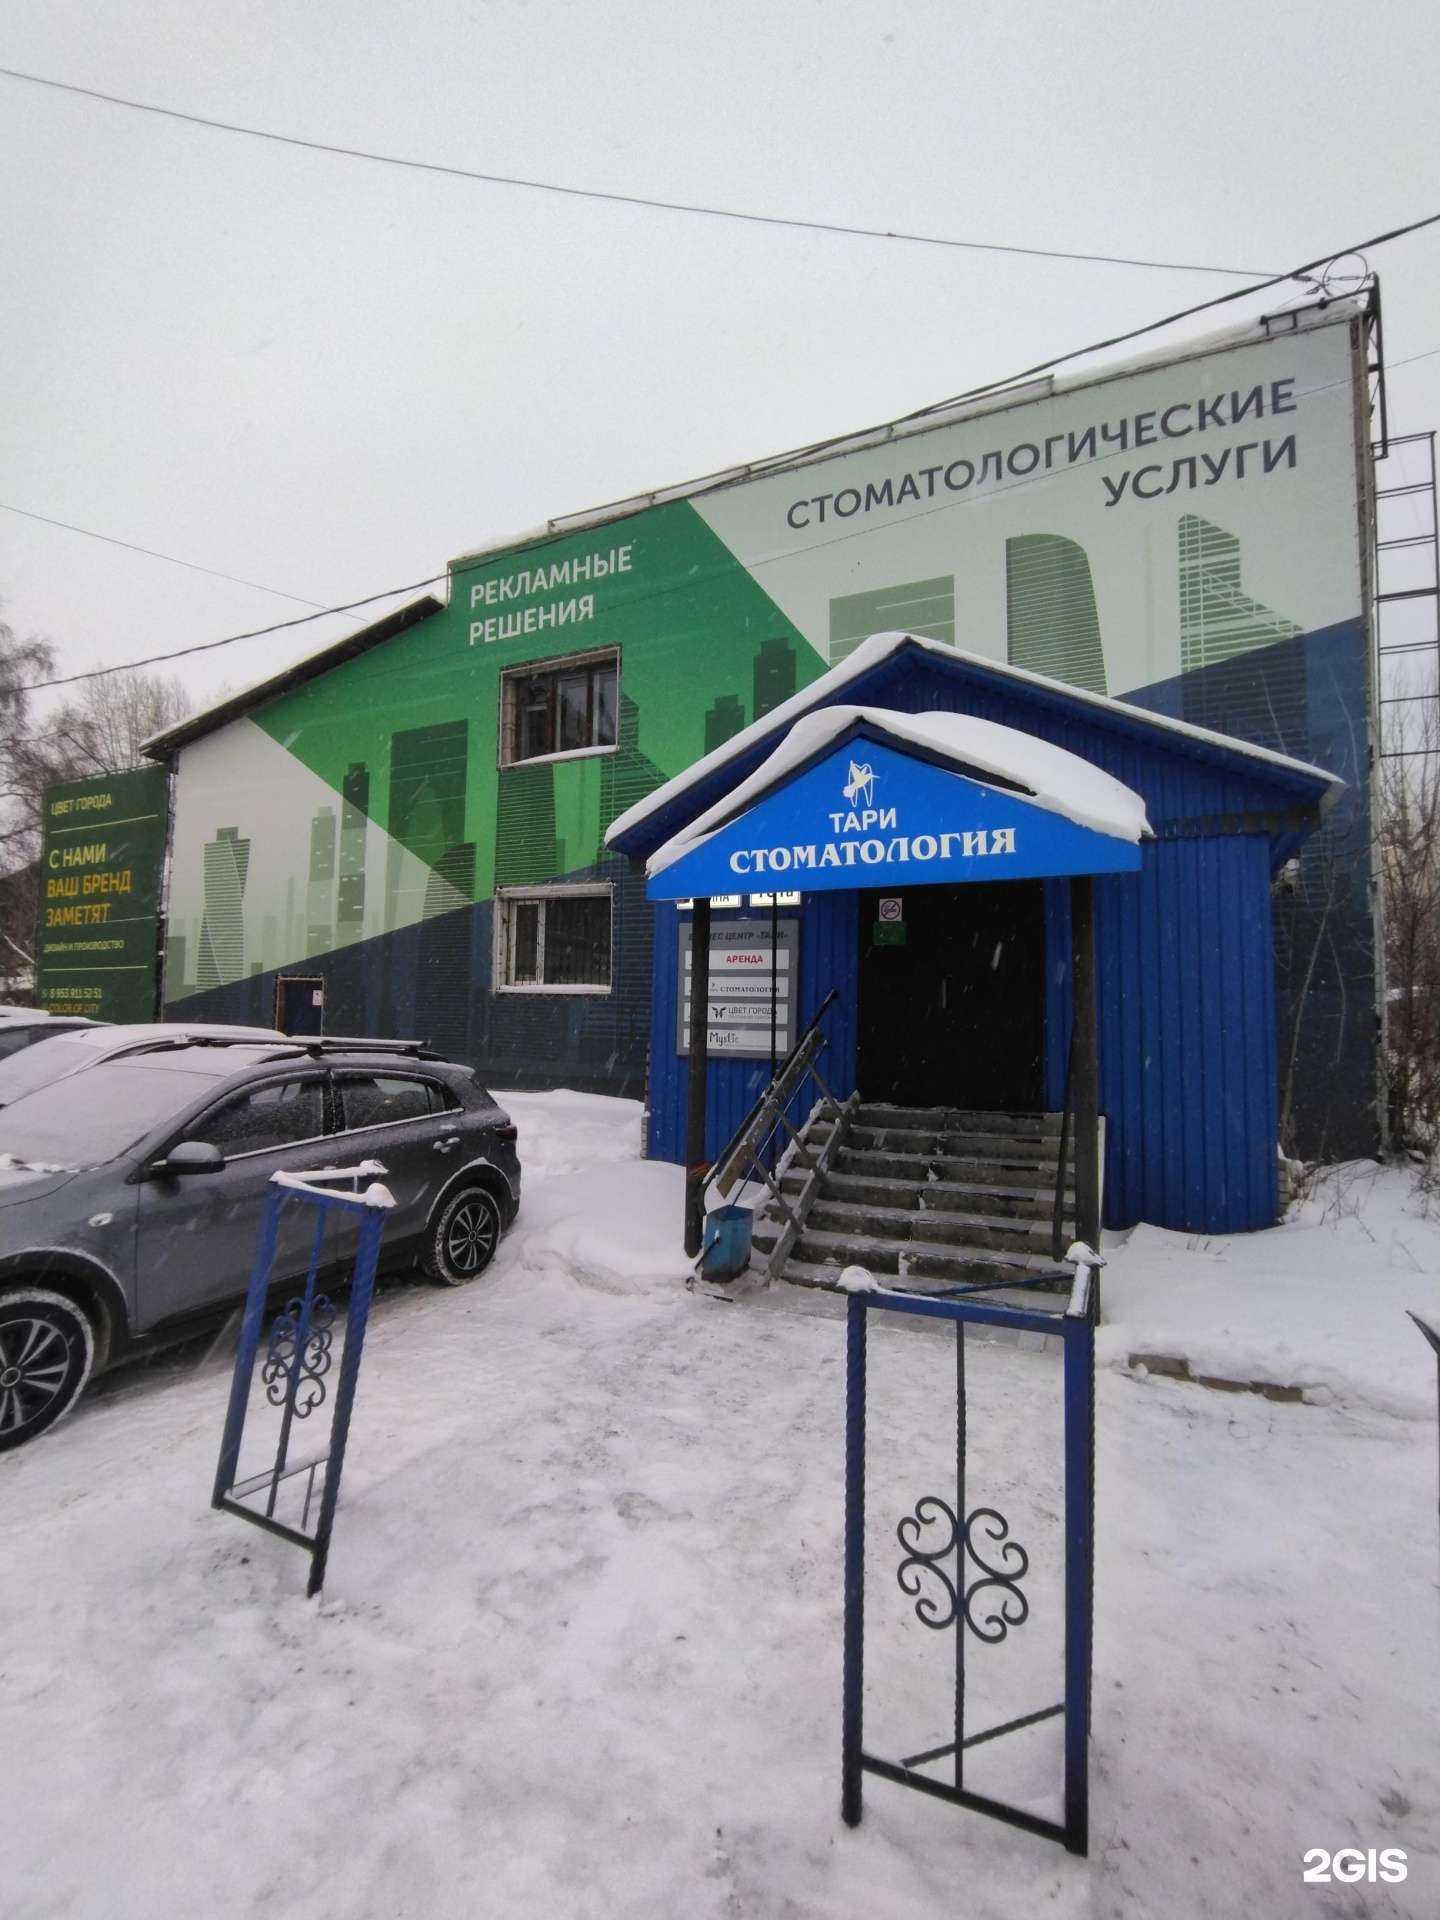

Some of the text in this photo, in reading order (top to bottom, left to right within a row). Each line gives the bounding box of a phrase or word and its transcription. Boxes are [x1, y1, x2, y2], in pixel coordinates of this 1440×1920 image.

[787, 378, 1298, 529] СТОМАТОЛОГИЧЕСКИЕ
[1102, 435, 1298, 507] УСЛУГИ
[470, 545, 633, 608] РЕКЛАМНЫЕ
[469, 594, 594, 646] РЕШЕНИЯ
[51, 793, 112, 817] ЦВЕТ ГОРОДА
[828, 807, 897, 833] ТАРИ
[49, 843, 106, 869] С НАМИ
[729, 827, 1017, 874] СТОМАТОЛОГИЯ
[47, 870, 131, 898] ВАШ БРЕНД
[46, 903, 112, 928] ЗАМЕТЯТ
[726, 955, 764, 964] АРЕНДА
[748, 1007, 777, 1015] ГОРОД
